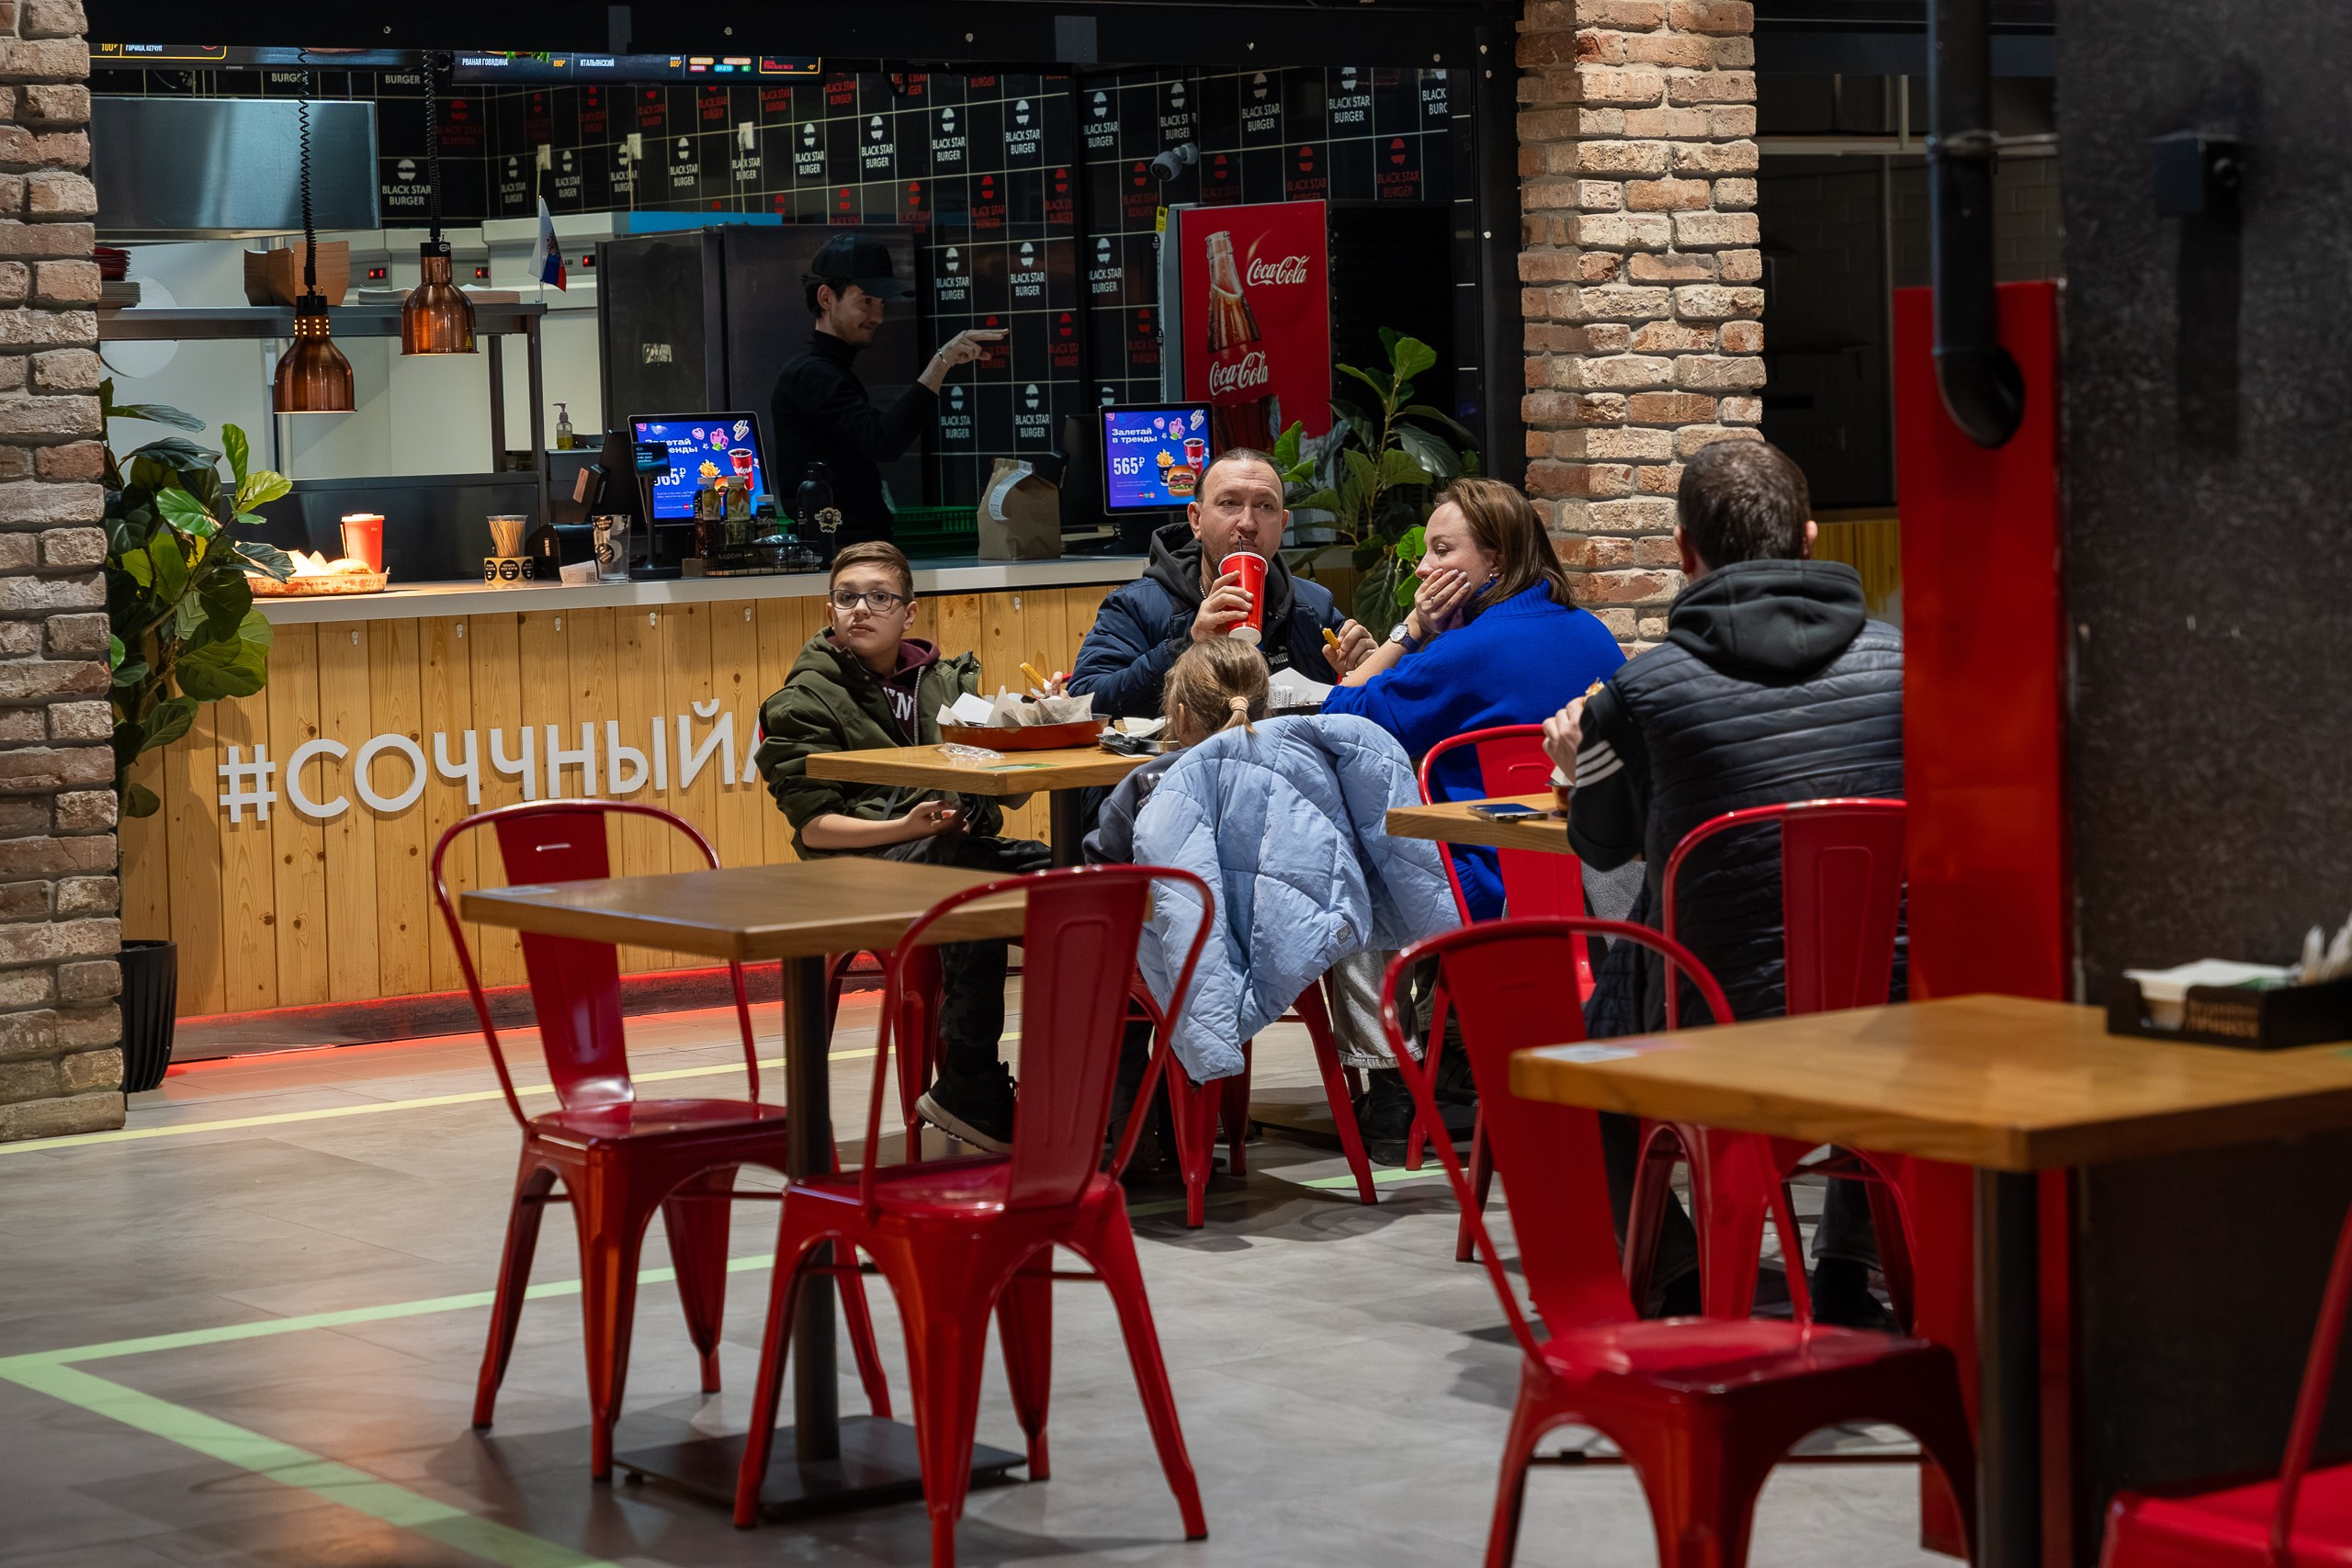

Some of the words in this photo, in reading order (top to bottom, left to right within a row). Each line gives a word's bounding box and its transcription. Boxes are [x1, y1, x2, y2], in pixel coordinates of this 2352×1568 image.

[462, 58, 481, 66] РВАНАЯ
[385, 74, 420, 85] BURGER
[1422, 87, 1446, 102] BLACK
[1329, 97, 1351, 109] BLACK
[1352, 96, 1371, 107] STAR
[1242, 106, 1263, 119] BLACK
[1263, 102, 1281, 115] STAR
[1334, 110, 1364, 123] BURGER
[1160, 116, 1180, 128] BLACK
[1181, 112, 1198, 123] STR
[1248, 118, 1274, 132] BURGER
[1083, 123, 1102, 135] BLACK
[1102, 121, 1119, 133] STAR
[1165, 127, 1190, 141] BURGE
[1005, 130, 1024, 142] BLACK
[1025, 129, 1041, 140] STAR
[1088, 135, 1114, 148] BURGER
[933, 139, 951, 150] BLACK
[951, 136, 966, 147] STAR
[1011, 142, 1035, 154] BURGER
[861, 146, 878, 157] BLACK
[879, 143, 893, 154] STAR
[937, 150, 961, 162] BURGER
[749, 157, 761, 167] STAR
[795, 152, 811, 163] BLACK
[811, 150, 824, 161] STAR
[865, 156, 889, 168] BURGER
[670, 165, 684, 176] BLACK
[685, 164, 698, 174] STAR
[799, 163, 820, 175] BURGER
[555, 177, 569, 187] BLACK
[570, 175, 581, 186] STAR
[610, 172, 625, 182] BLACK
[625, 170, 638, 179] SAR
[673, 175, 694, 187] BURGER
[382, 185, 409, 195] BLACK
[411, 185, 432, 195] STAR
[501, 184, 514, 193] BLACK
[515, 182, 526, 191] STAR
[559, 187, 577, 198] BURGER
[389, 196, 424, 206] BURGER
[504, 193, 523, 203] BURGER
[1108, 267, 1123, 278] STAR
[1246, 254, 1311, 287] Coca-Cola
[936, 277, 956, 288] BLACK
[956, 276, 969, 287] STAR
[1011, 274, 1030, 284] BLACK
[1030, 271, 1045, 282] STAR
[1015, 285, 1040, 297] BURGER
[1091, 281, 1117, 293] BURGER
[941, 289, 965, 300] BURGER
[1208, 350, 1269, 397] Coca-Cola
[941, 416, 958, 426] BLACK
[959, 415, 971, 425] STA
[1015, 415, 1035, 425] BLACK
[1035, 413, 1050, 424] STAR
[945, 428, 969, 439] BURGER
[1020, 427, 1045, 437] BURGER
[1112, 427, 1152, 436] Залетай
[1120, 435, 1158, 445] тренды
[219, 698, 762, 824] #СОЧЧНЫЙ
